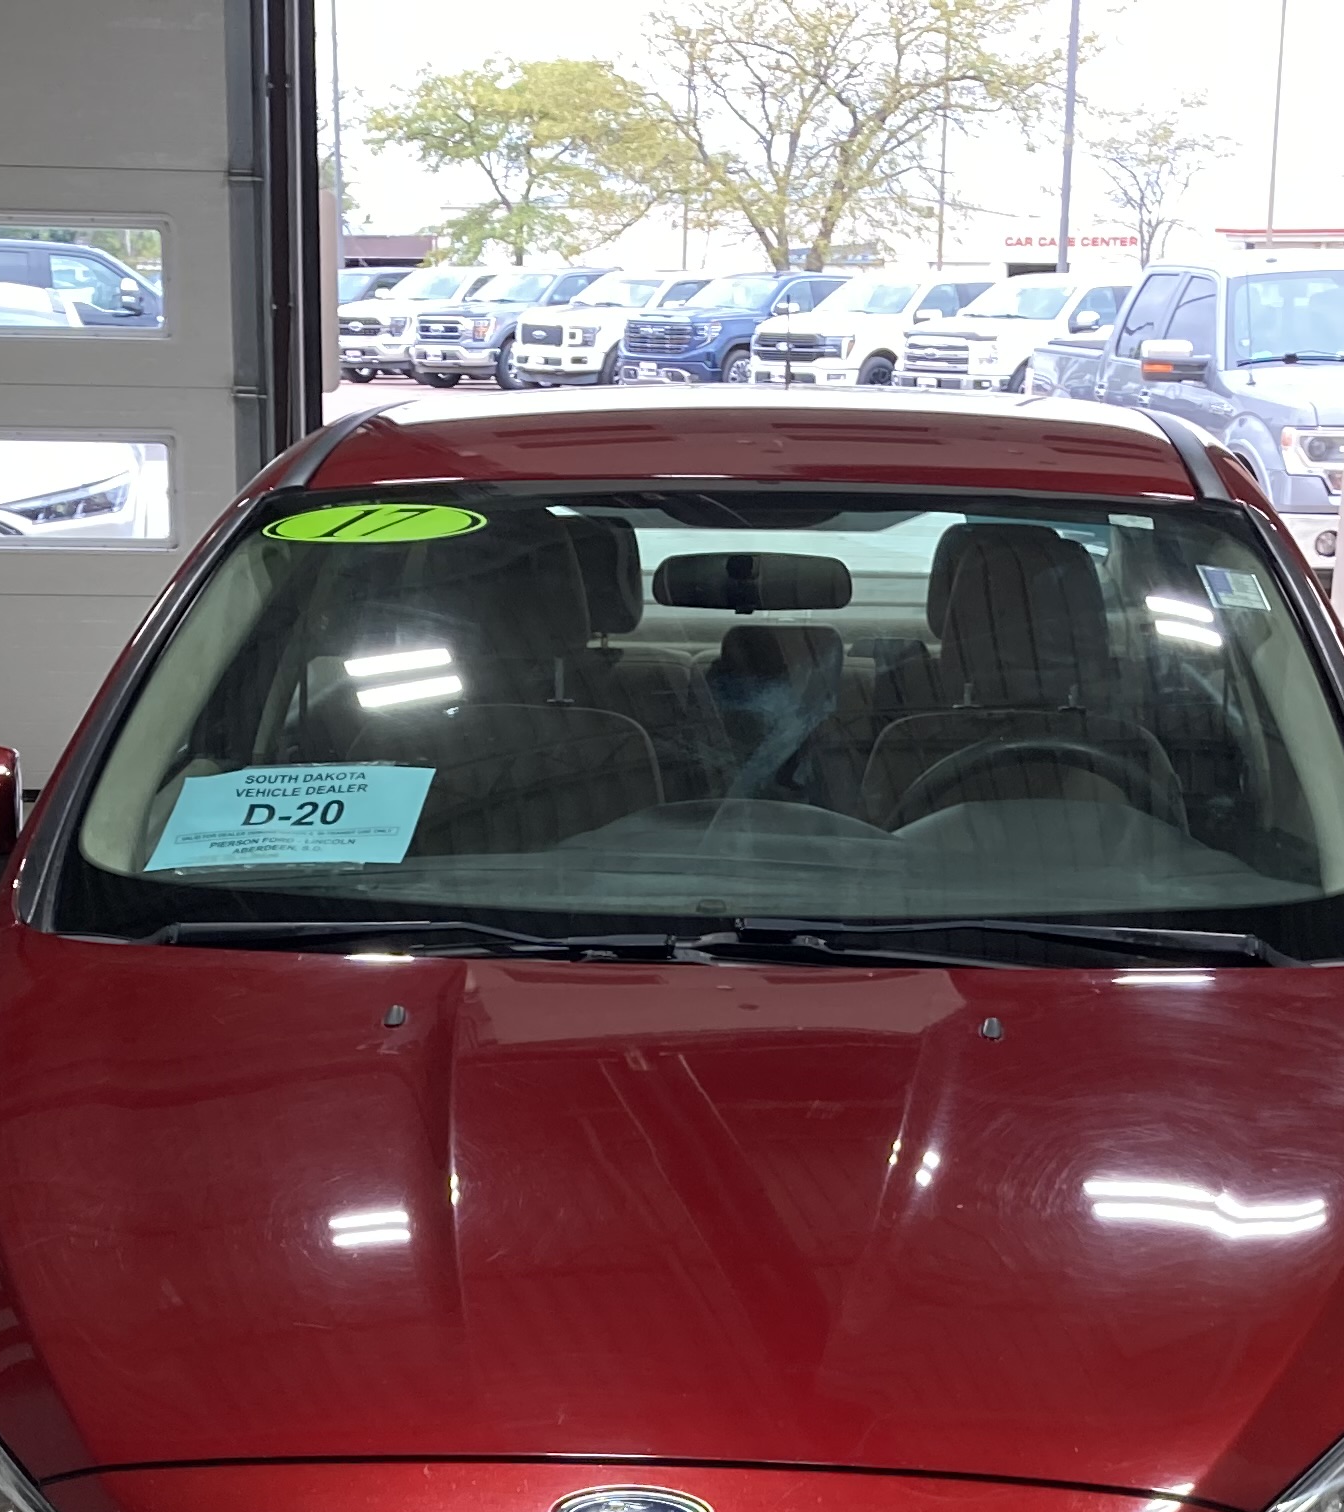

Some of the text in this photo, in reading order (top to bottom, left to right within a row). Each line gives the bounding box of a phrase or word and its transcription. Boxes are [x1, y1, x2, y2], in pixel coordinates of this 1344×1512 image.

[1004, 236, 1138, 247] CAR CAE CENTER
[314, 508, 437, 538] 17
[244, 771, 366, 784] SOUTH DAKOTA
[235, 783, 369, 798] VEHICLE DEALER
[240, 799, 345, 826] D-20
[208, 838, 260, 848] PIERSON
